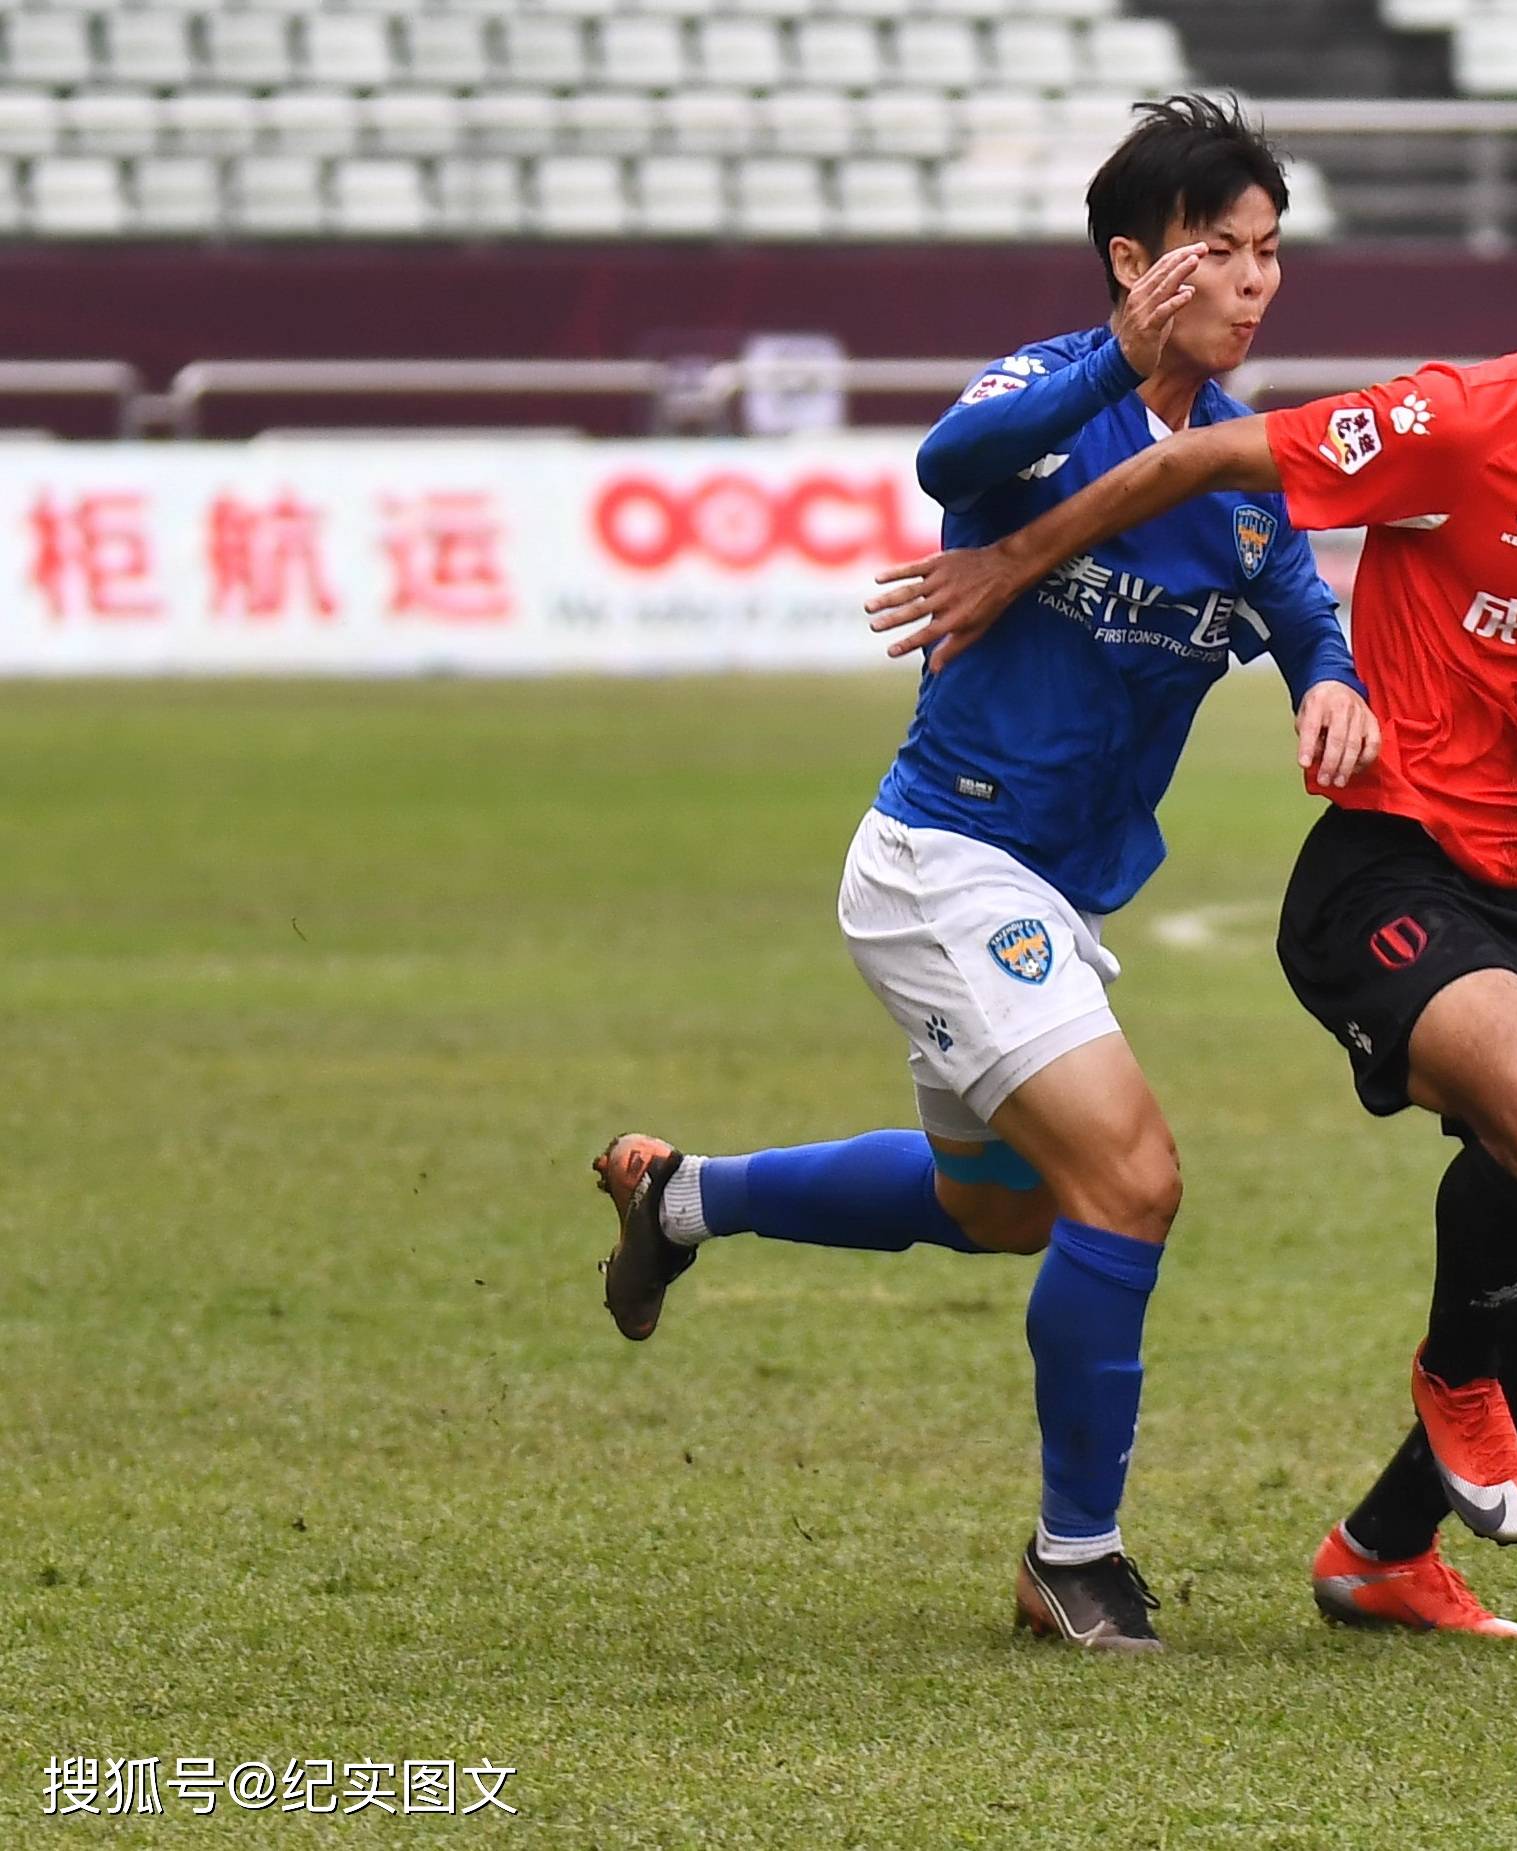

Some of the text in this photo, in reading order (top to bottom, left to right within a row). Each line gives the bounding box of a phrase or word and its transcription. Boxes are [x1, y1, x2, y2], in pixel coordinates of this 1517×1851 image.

[26, 484, 519, 624] 柜航运
[594, 472, 936, 570] OOCL
[1094, 626, 1128, 644] FIRST
